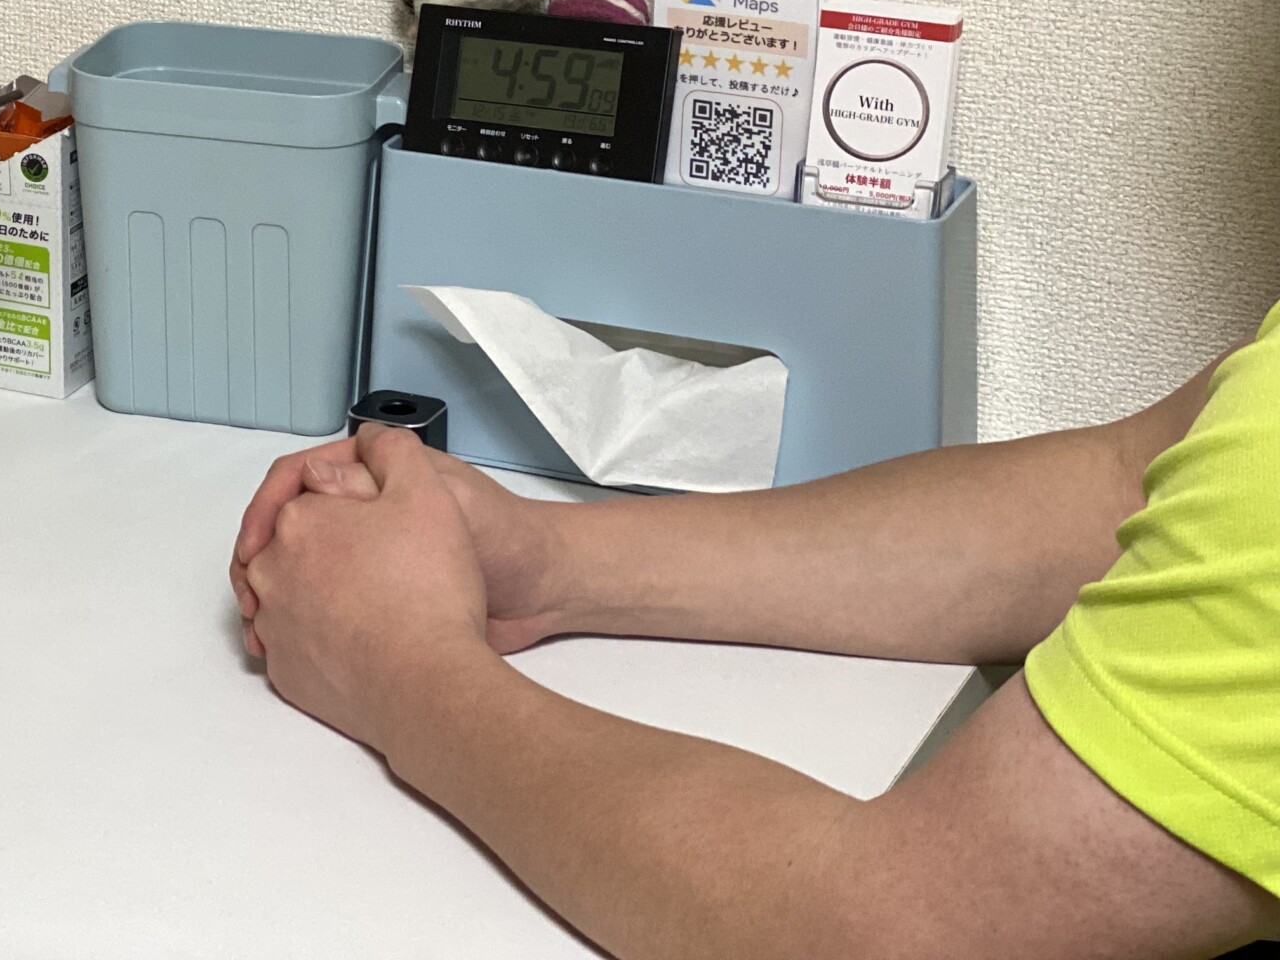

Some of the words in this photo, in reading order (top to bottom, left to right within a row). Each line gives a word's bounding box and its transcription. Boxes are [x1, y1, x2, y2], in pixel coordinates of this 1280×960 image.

[445, 18, 482, 29] RHYTHM
[702, 15, 772, 32] 応援レビュー
[852, 15, 900, 28] HIGH-GRADE
[901, 20, 918, 29] GYM
[491, 47, 596, 110] 4:59
[859, 95, 894, 112] With
[830, 108, 894, 125] HIGH-GRADE
[896, 117, 919, 128] GYM
[447, 125, 467, 133] モニター
[521, 132, 540, 140] リセット
[25, 182, 45, 190] CHOICE
[845, 173, 891, 190] 体験半額
